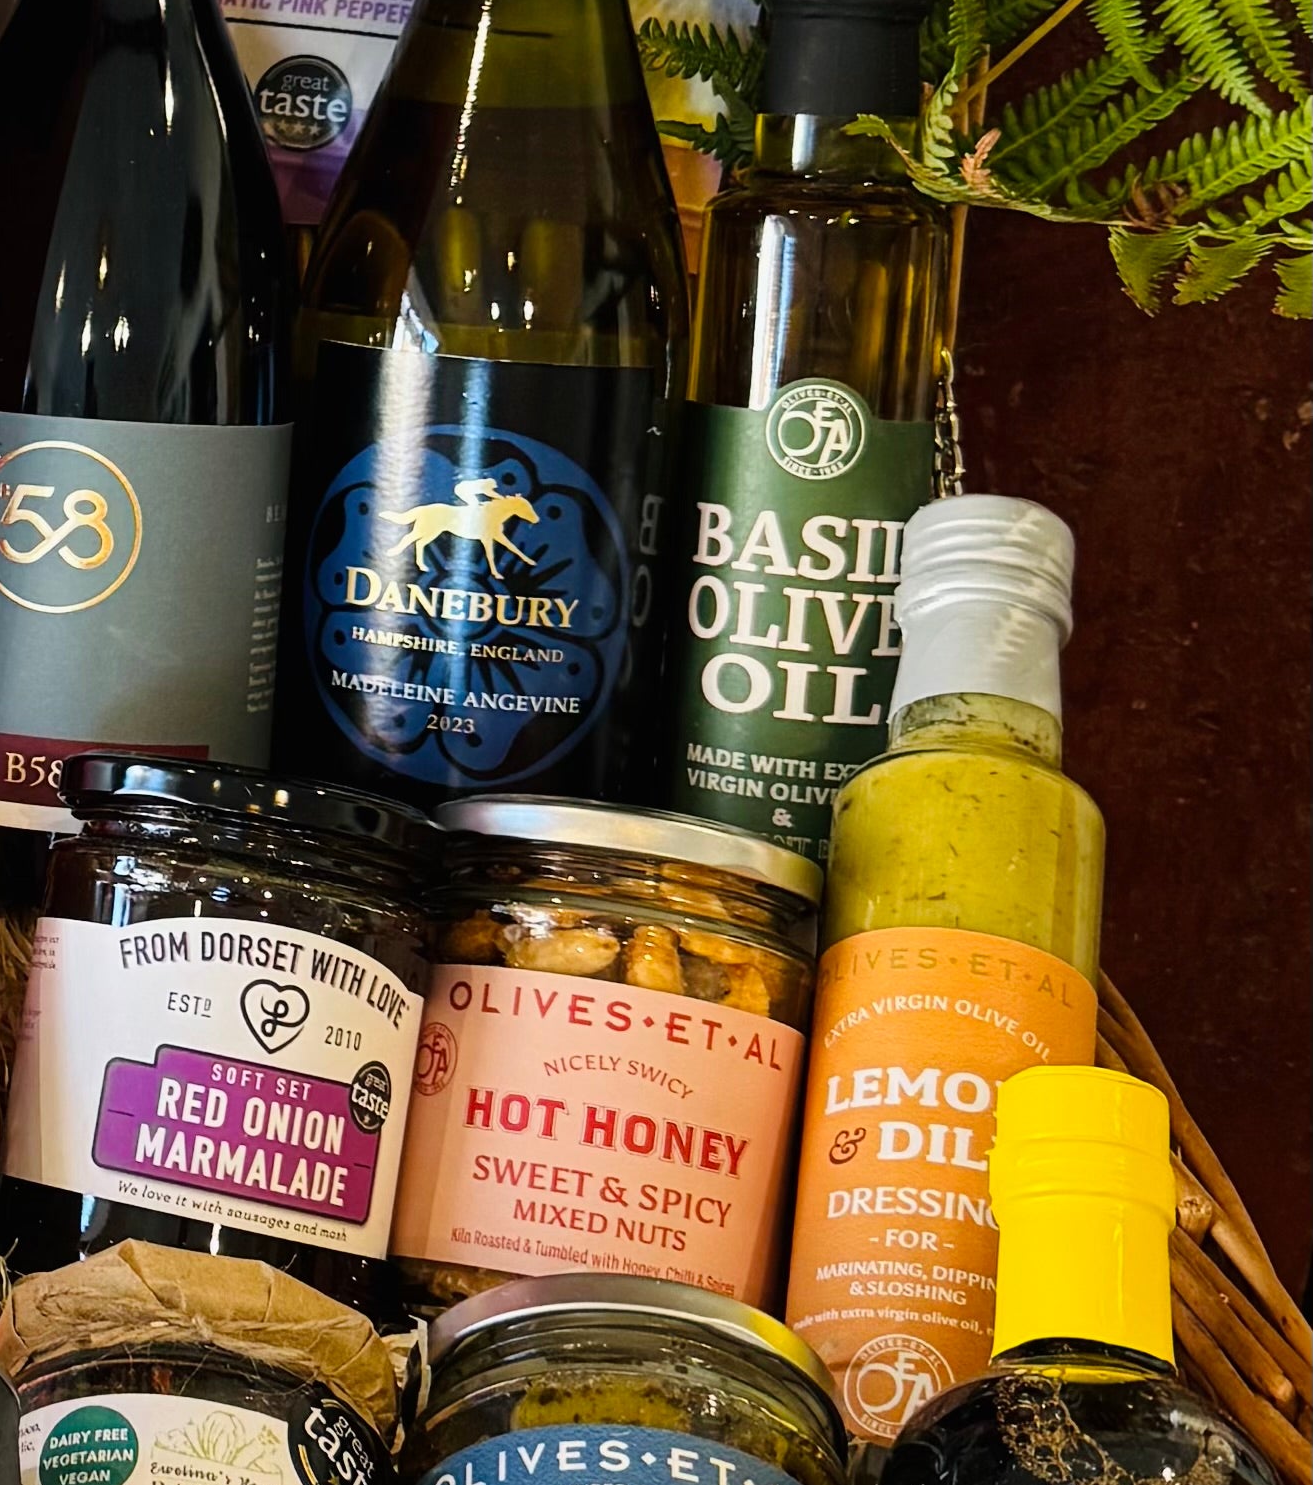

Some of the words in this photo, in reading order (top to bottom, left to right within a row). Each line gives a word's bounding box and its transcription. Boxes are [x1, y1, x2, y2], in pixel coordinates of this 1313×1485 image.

[260, 84, 348, 123] taste
[345, 566, 579, 629] DANEBURY
[470, 643, 564, 664] ENGLAND
[331, 671, 455, 706] MADELEINE
[462, 690, 581, 714] ANGEVINE
[702, 653, 881, 726] OIL
[426, 714, 476, 735] 2023
[686, 767, 764, 798] VIRGIN
[750, 753, 816, 779] WITH
[119, 931, 188, 969] FROM
[201, 931, 305, 973] DORSET
[310, 948, 367, 996] WITH
[368, 971, 406, 1030] LOVE
[872, 994, 949, 1016] VIRGIN
[954, 999, 1020, 1036] OLIVE
[211, 1063, 265, 1090] SOFT
[275, 1077, 313, 1102] SET
[544, 1054, 621, 1076] NICELY
[626, 1060, 694, 1100] SWICY
[157, 1077, 228, 1128] RED
[242, 1095, 345, 1155] ONION
[463, 1087, 570, 1140] HOT
[579, 1100, 750, 1180] HONEY
[134, 1122, 348, 1208] MARMALADE
[473, 1155, 593, 1198] SWEET
[638, 1184, 732, 1228] SPICY
[513, 1199, 607, 1234] MIXED
[616, 1219, 687, 1252] NUTS
[885, 1228, 939, 1251] FOR
[816, 1260, 927, 1281] MARINATING,
[865, 1282, 967, 1306] SLOSHING
[49, 1430, 92, 1448] DAIRY
[42, 1448, 134, 1470] VEGETARIAN
[58, 1469, 111, 1485] VEGAN
